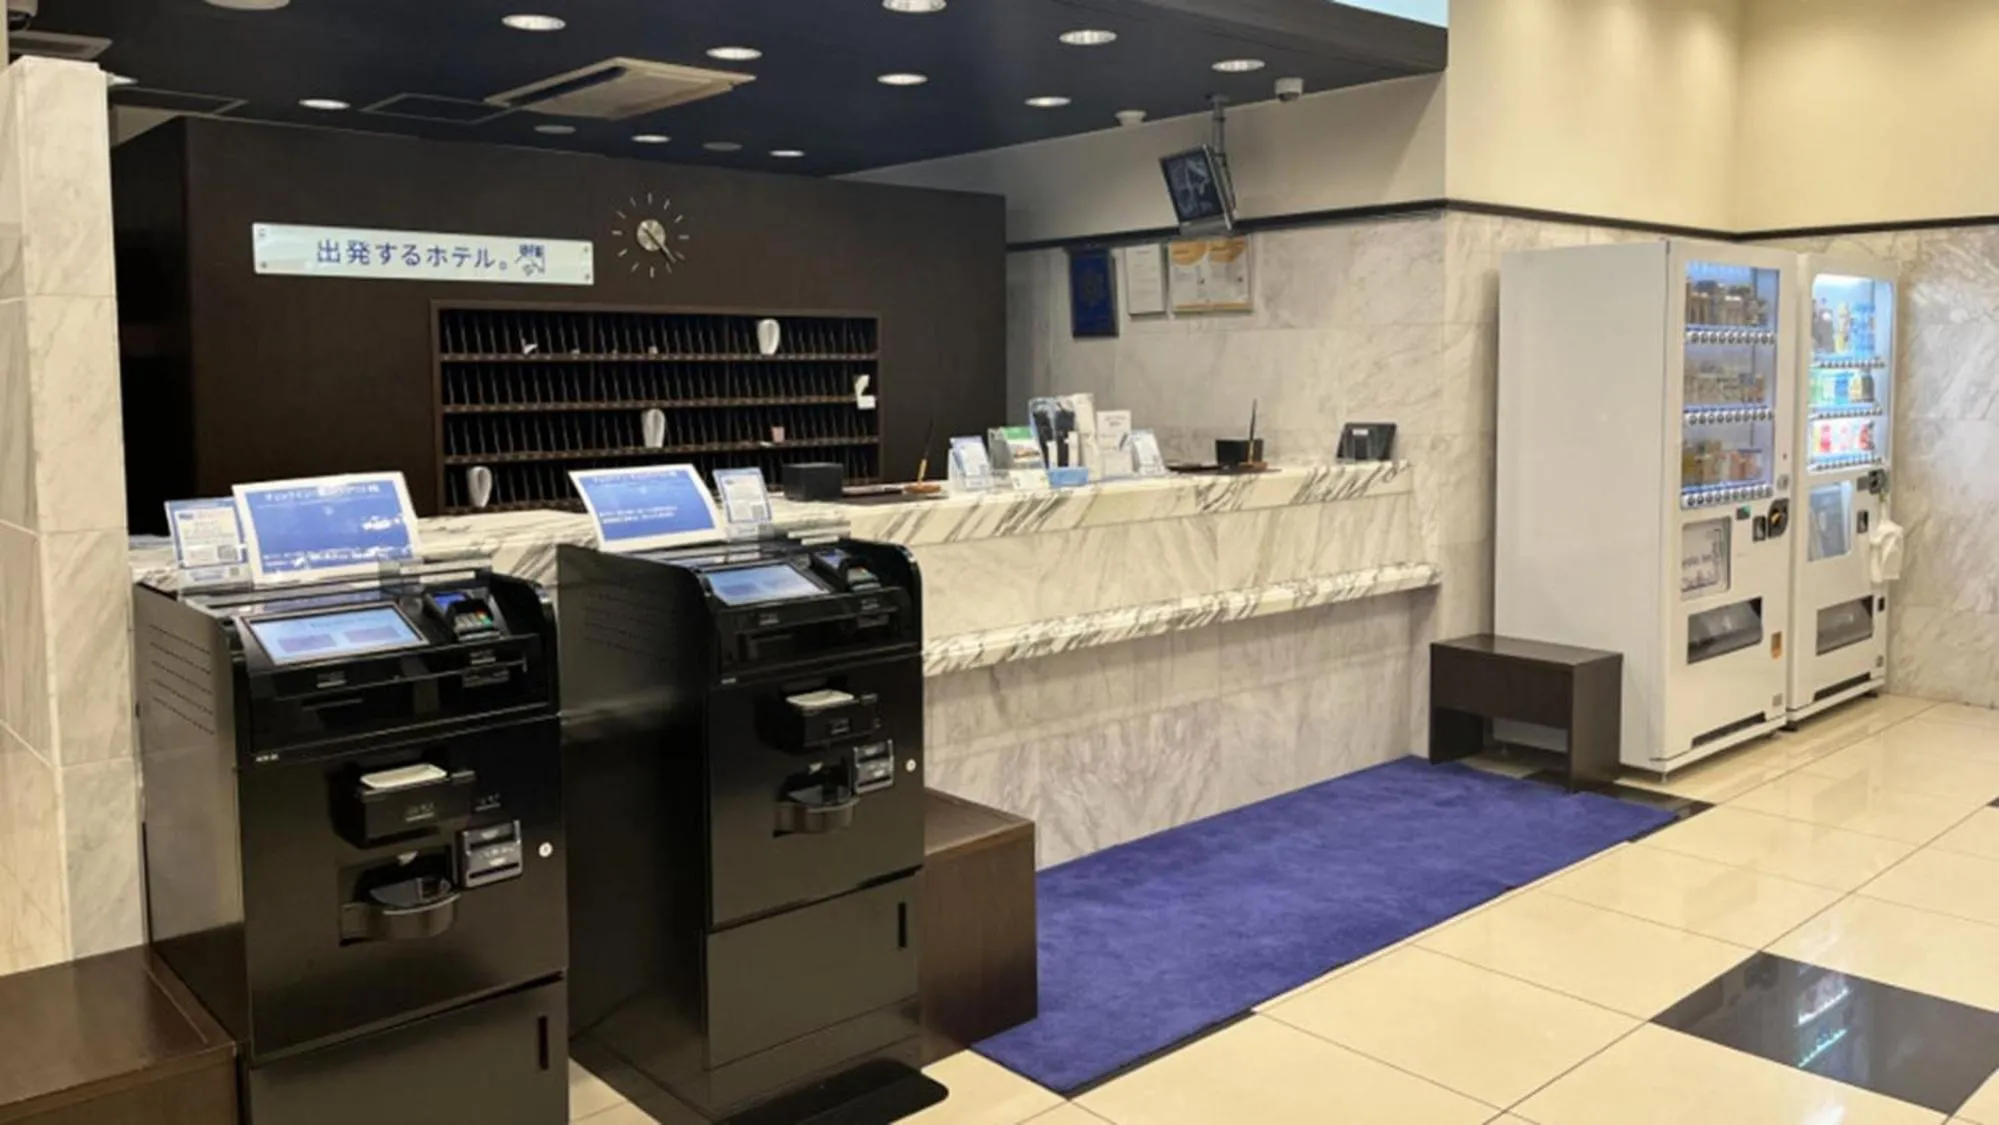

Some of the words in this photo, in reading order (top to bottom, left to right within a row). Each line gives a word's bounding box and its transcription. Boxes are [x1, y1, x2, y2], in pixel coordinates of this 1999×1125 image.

[316, 239, 507, 271] 出発するホテル。
